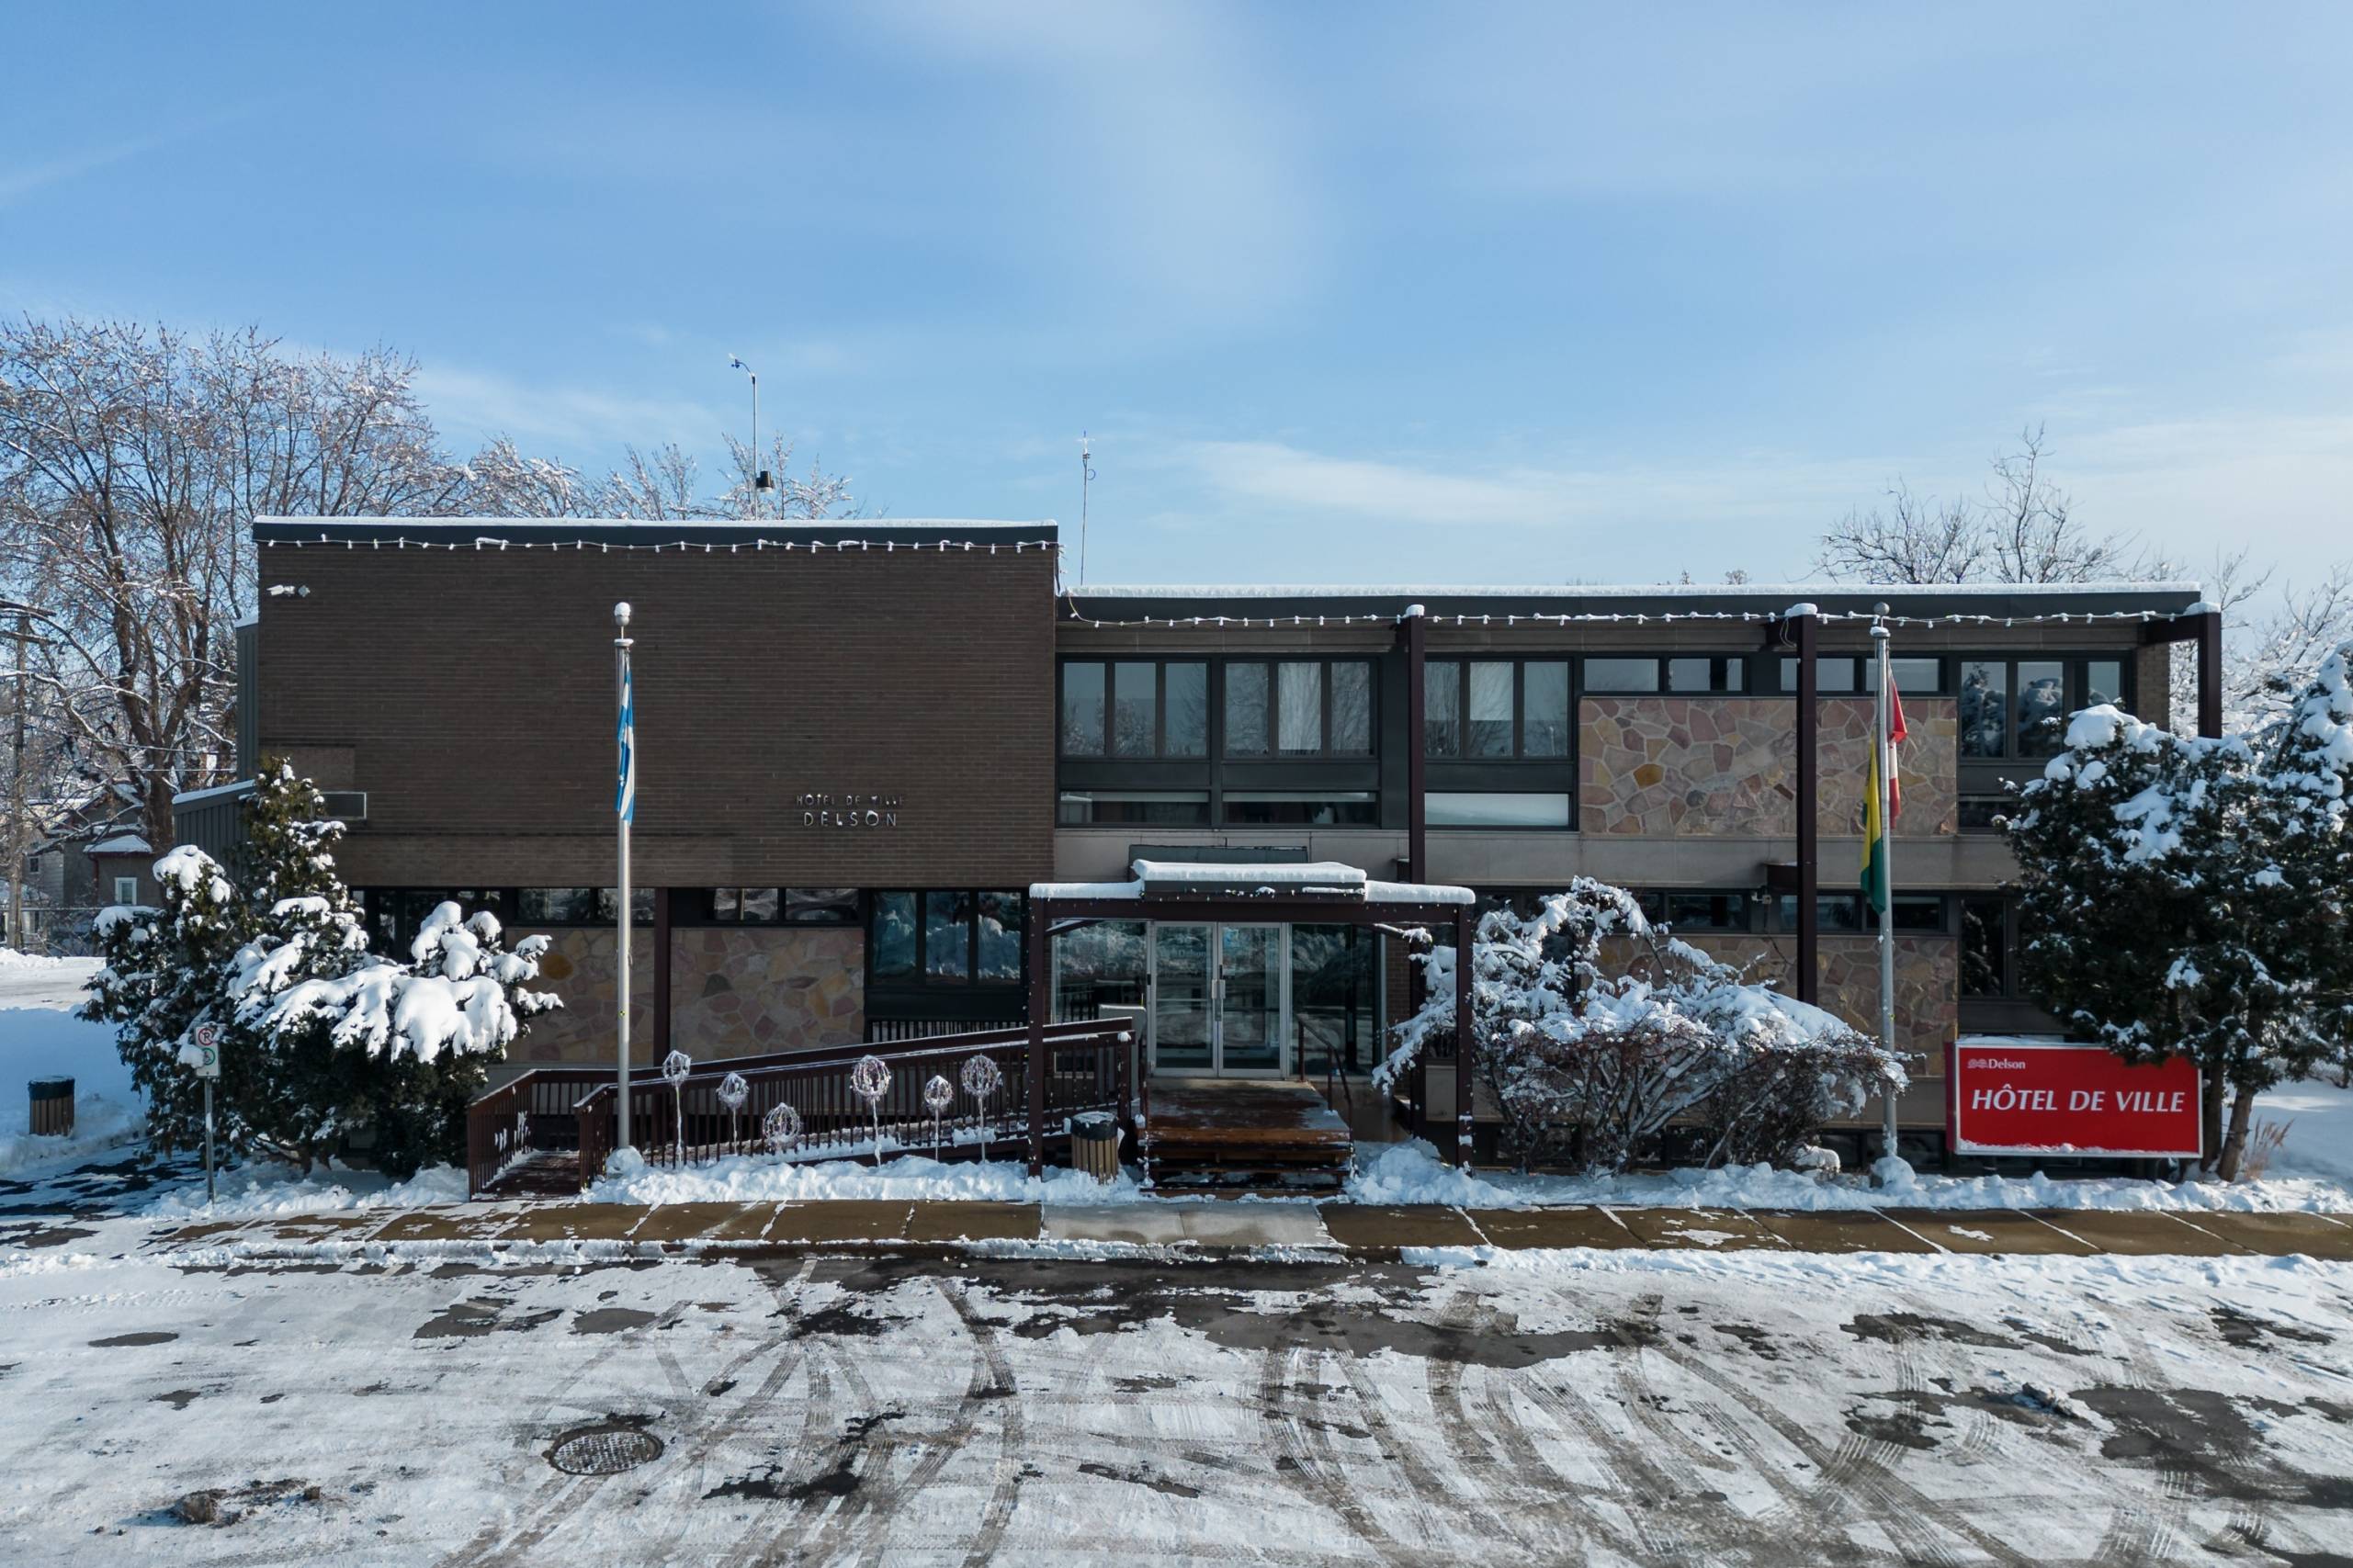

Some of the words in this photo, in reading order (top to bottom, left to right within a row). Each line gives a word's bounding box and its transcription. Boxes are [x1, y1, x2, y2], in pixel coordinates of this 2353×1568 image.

[846, 795, 860, 806] DE
[803, 809, 897, 827] DELSON
[1988, 1058, 2026, 1070] Delson
[1972, 1084, 2058, 1111] HÔTEL
[2069, 1090, 2106, 1111] DE
[2115, 1090, 2186, 1112] VILLE
